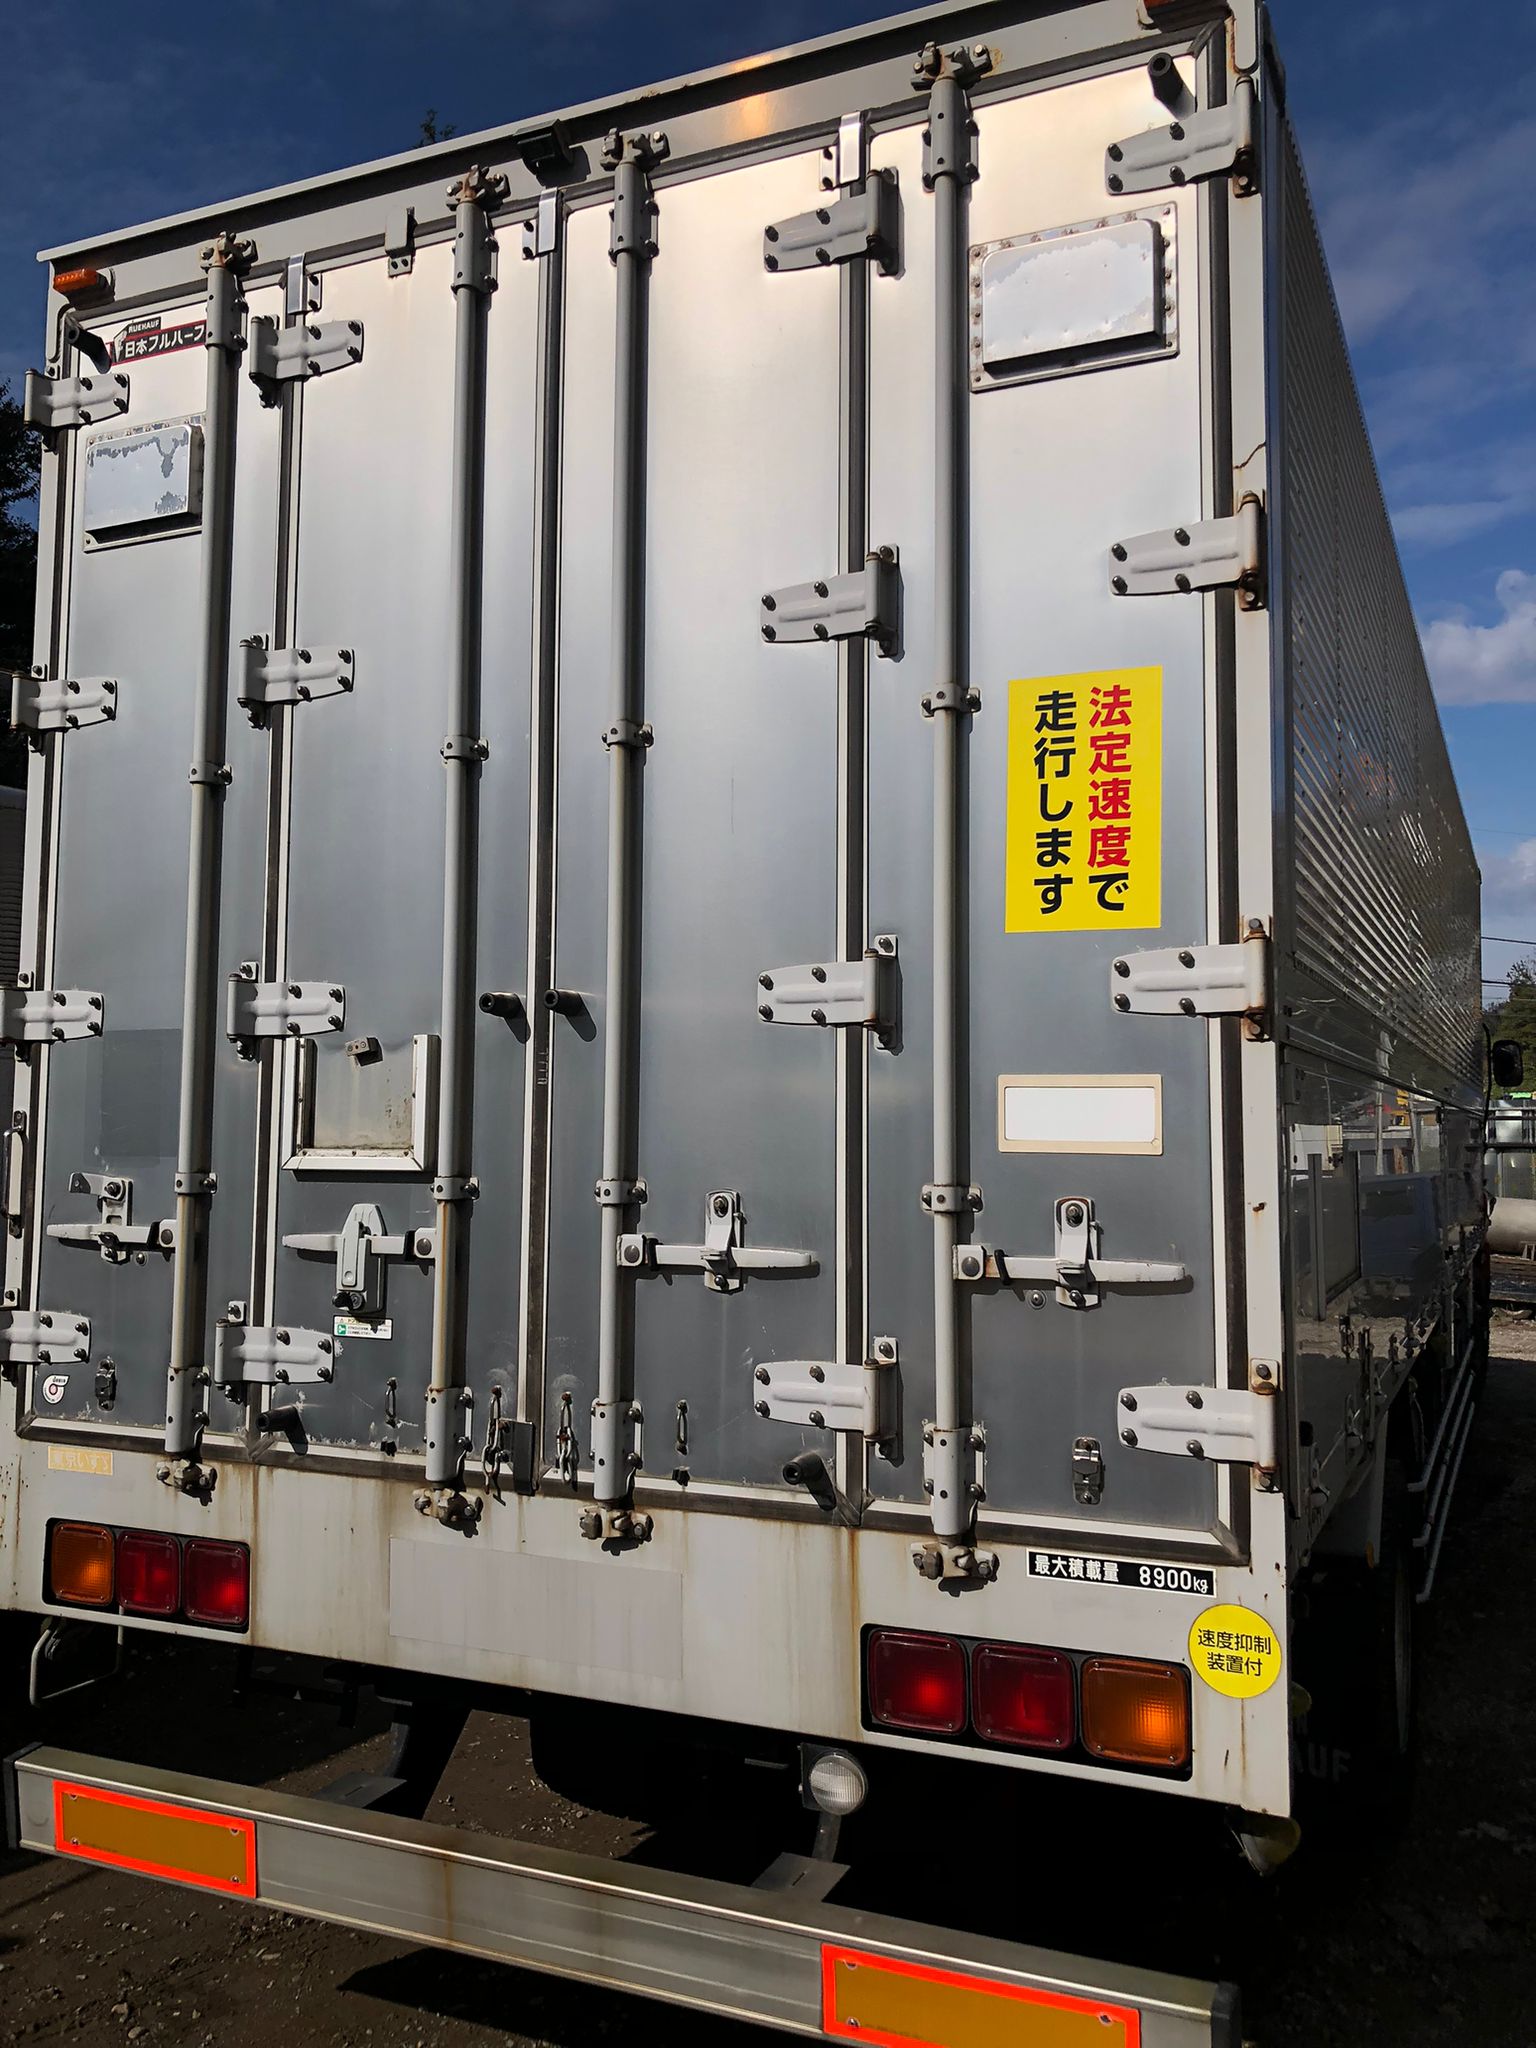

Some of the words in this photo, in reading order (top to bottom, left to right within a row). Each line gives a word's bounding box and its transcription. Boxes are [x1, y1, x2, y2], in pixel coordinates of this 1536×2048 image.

[125, 324, 205, 358] 日本フルハーフ
[1033, 690, 1077, 914] 走行します
[1087, 684, 1133, 911] 法定速度で
[1034, 1554, 1119, 1583] 最大積載量
[1139, 1565, 1209, 1594] 8900kg
[1197, 1628, 1273, 1656] 速度抑制
[1207, 1651, 1264, 1677] 装置付
